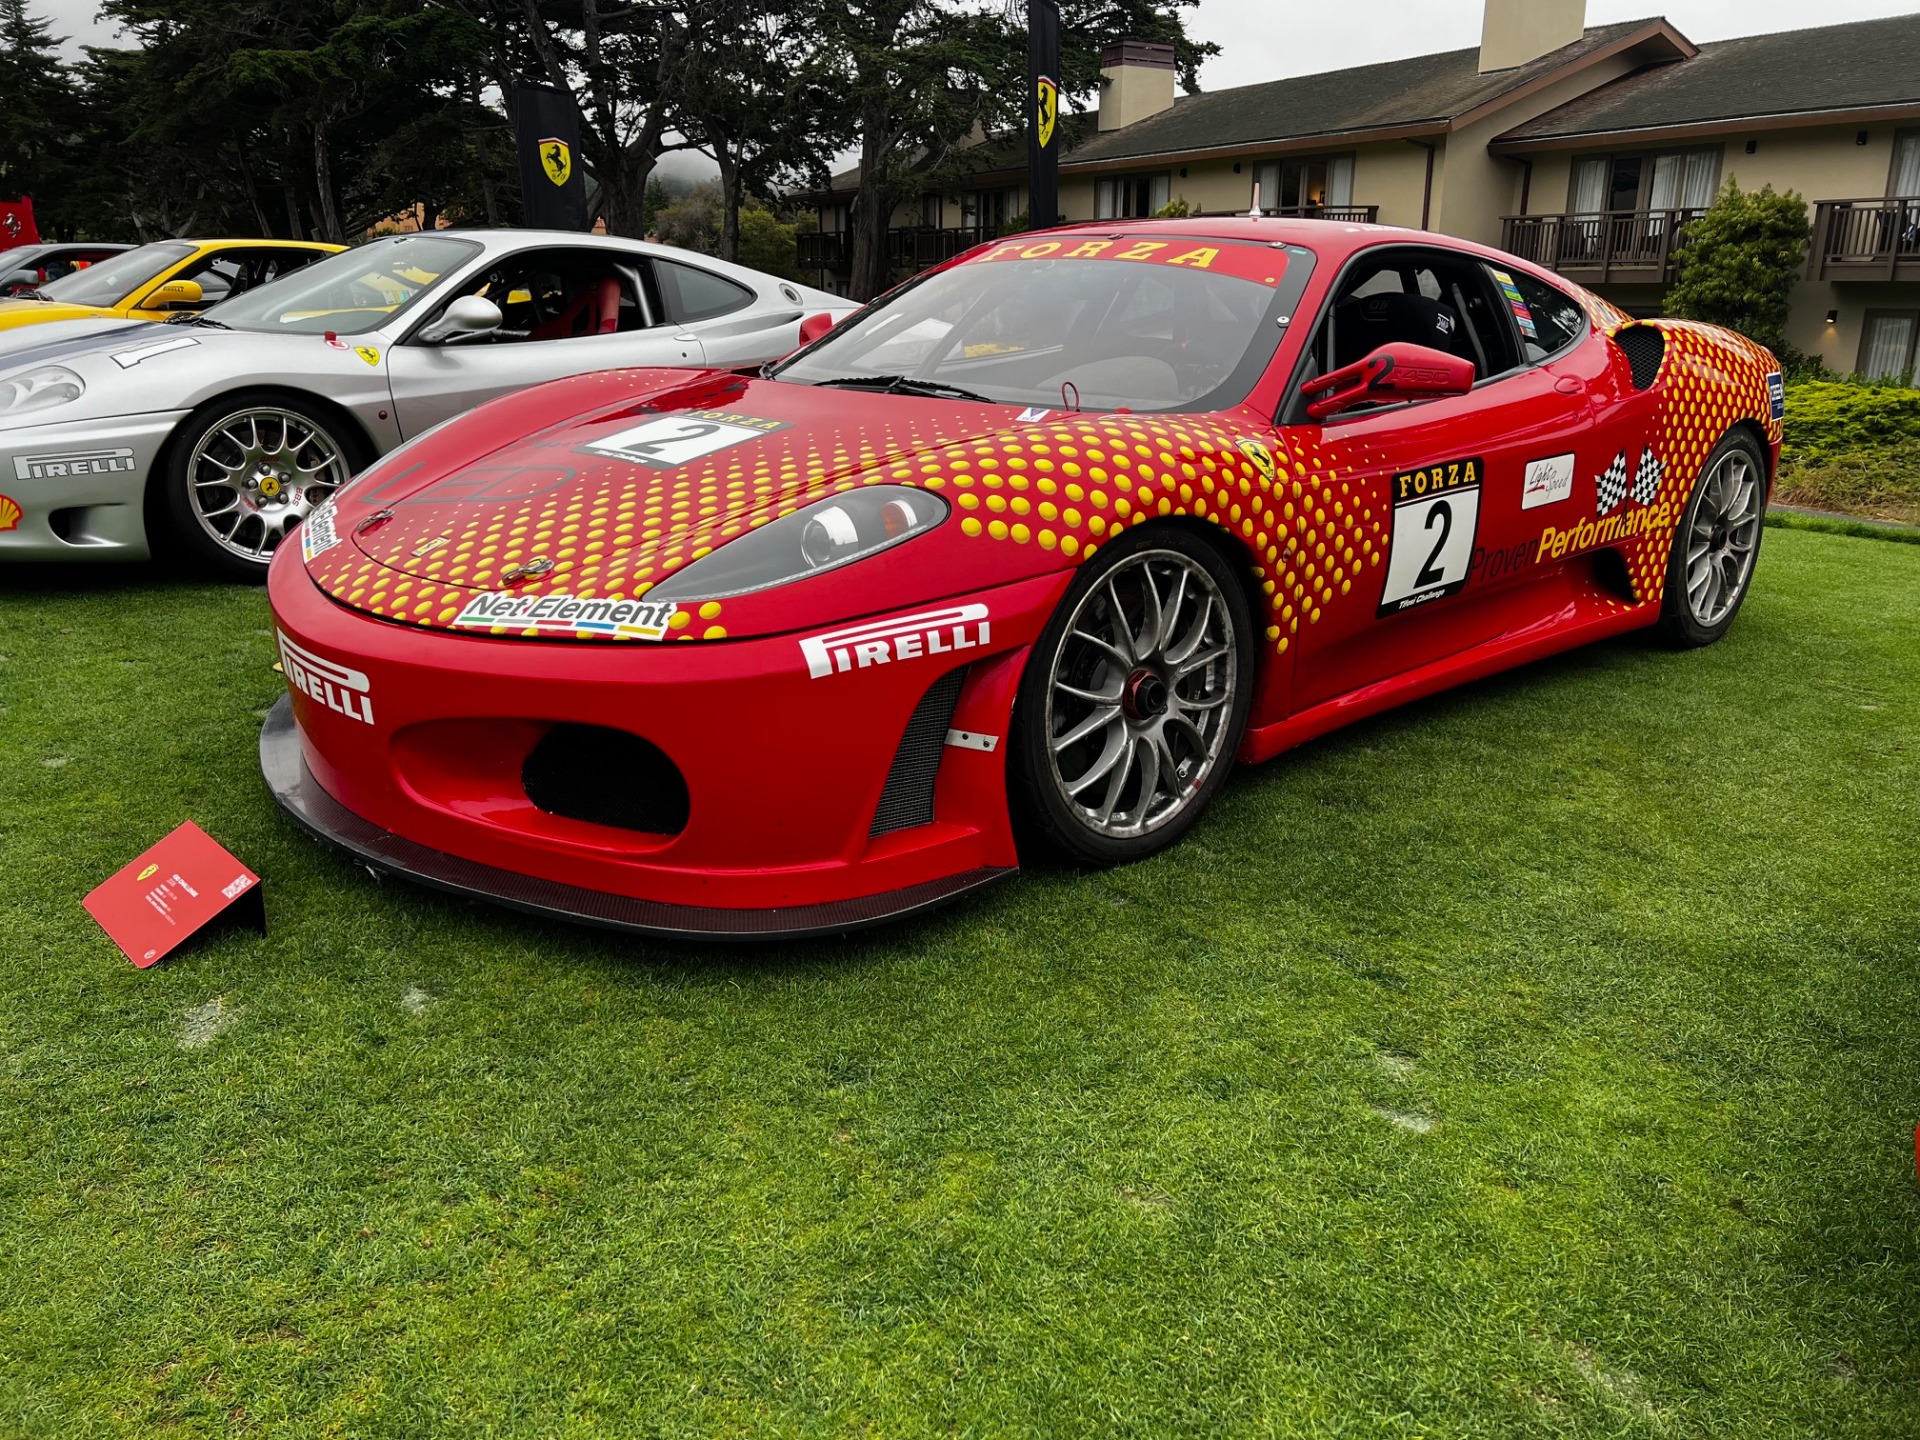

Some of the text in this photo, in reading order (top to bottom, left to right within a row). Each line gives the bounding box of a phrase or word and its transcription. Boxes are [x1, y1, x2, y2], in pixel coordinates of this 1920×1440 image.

[978, 241, 1221, 269] FORZA
[1367, 353, 1396, 391] 2
[686, 409, 781, 430] FORZA
[619, 424, 721, 455] 2
[12, 446, 136, 480] PIRELLI
[1399, 461, 1476, 498] FORZA
[358, 461, 578, 505] LED
[1412, 499, 1453, 590] 2
[1534, 501, 1671, 564] Performance
[465, 595, 673, 628] Net Element
[797, 602, 991, 680] PIRELLI
[276, 625, 375, 726] PIRELLI
